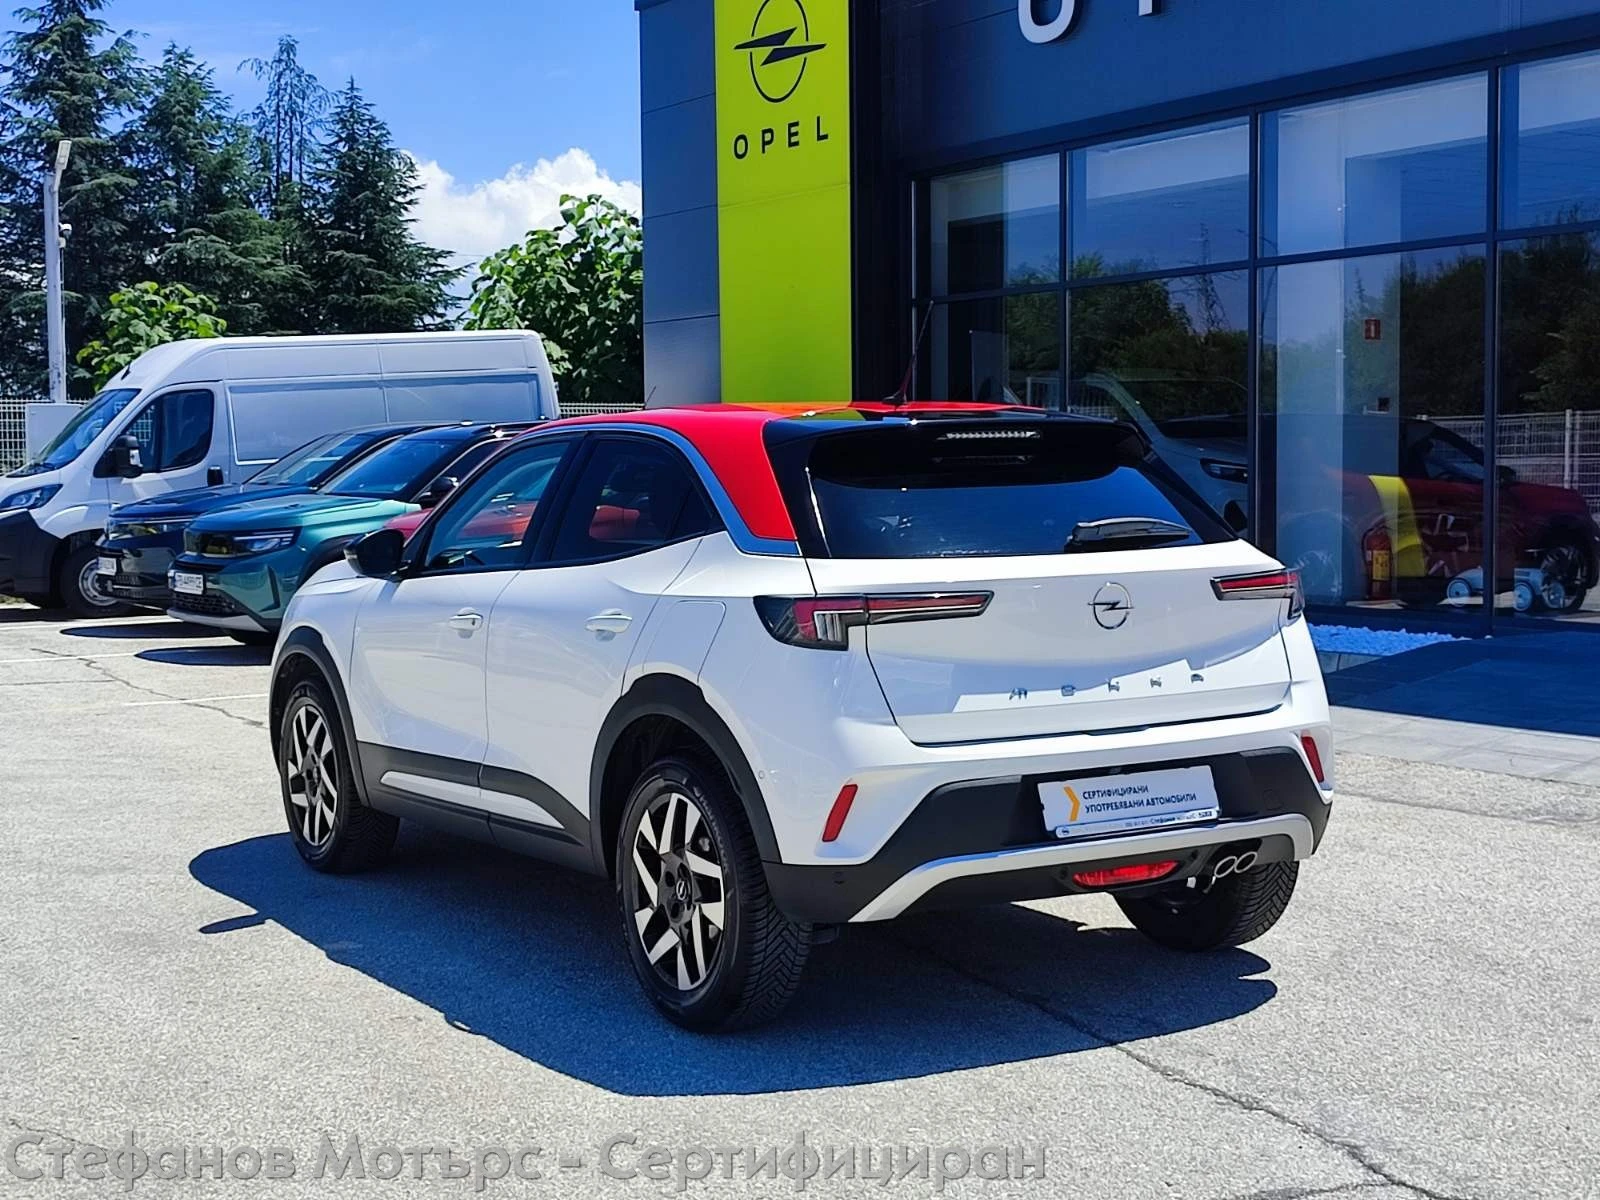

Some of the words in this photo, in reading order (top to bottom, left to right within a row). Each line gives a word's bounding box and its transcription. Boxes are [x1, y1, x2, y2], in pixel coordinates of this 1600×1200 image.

[734, 116, 829, 160] OPEL
[1082, 785, 1149, 800] СЕРТИФИЦИРАНИ
[1085, 799, 1145, 814] УПОТРЕБЯВАНИ
[1145, 793, 1197, 807] АВТОМОБИЛИ
